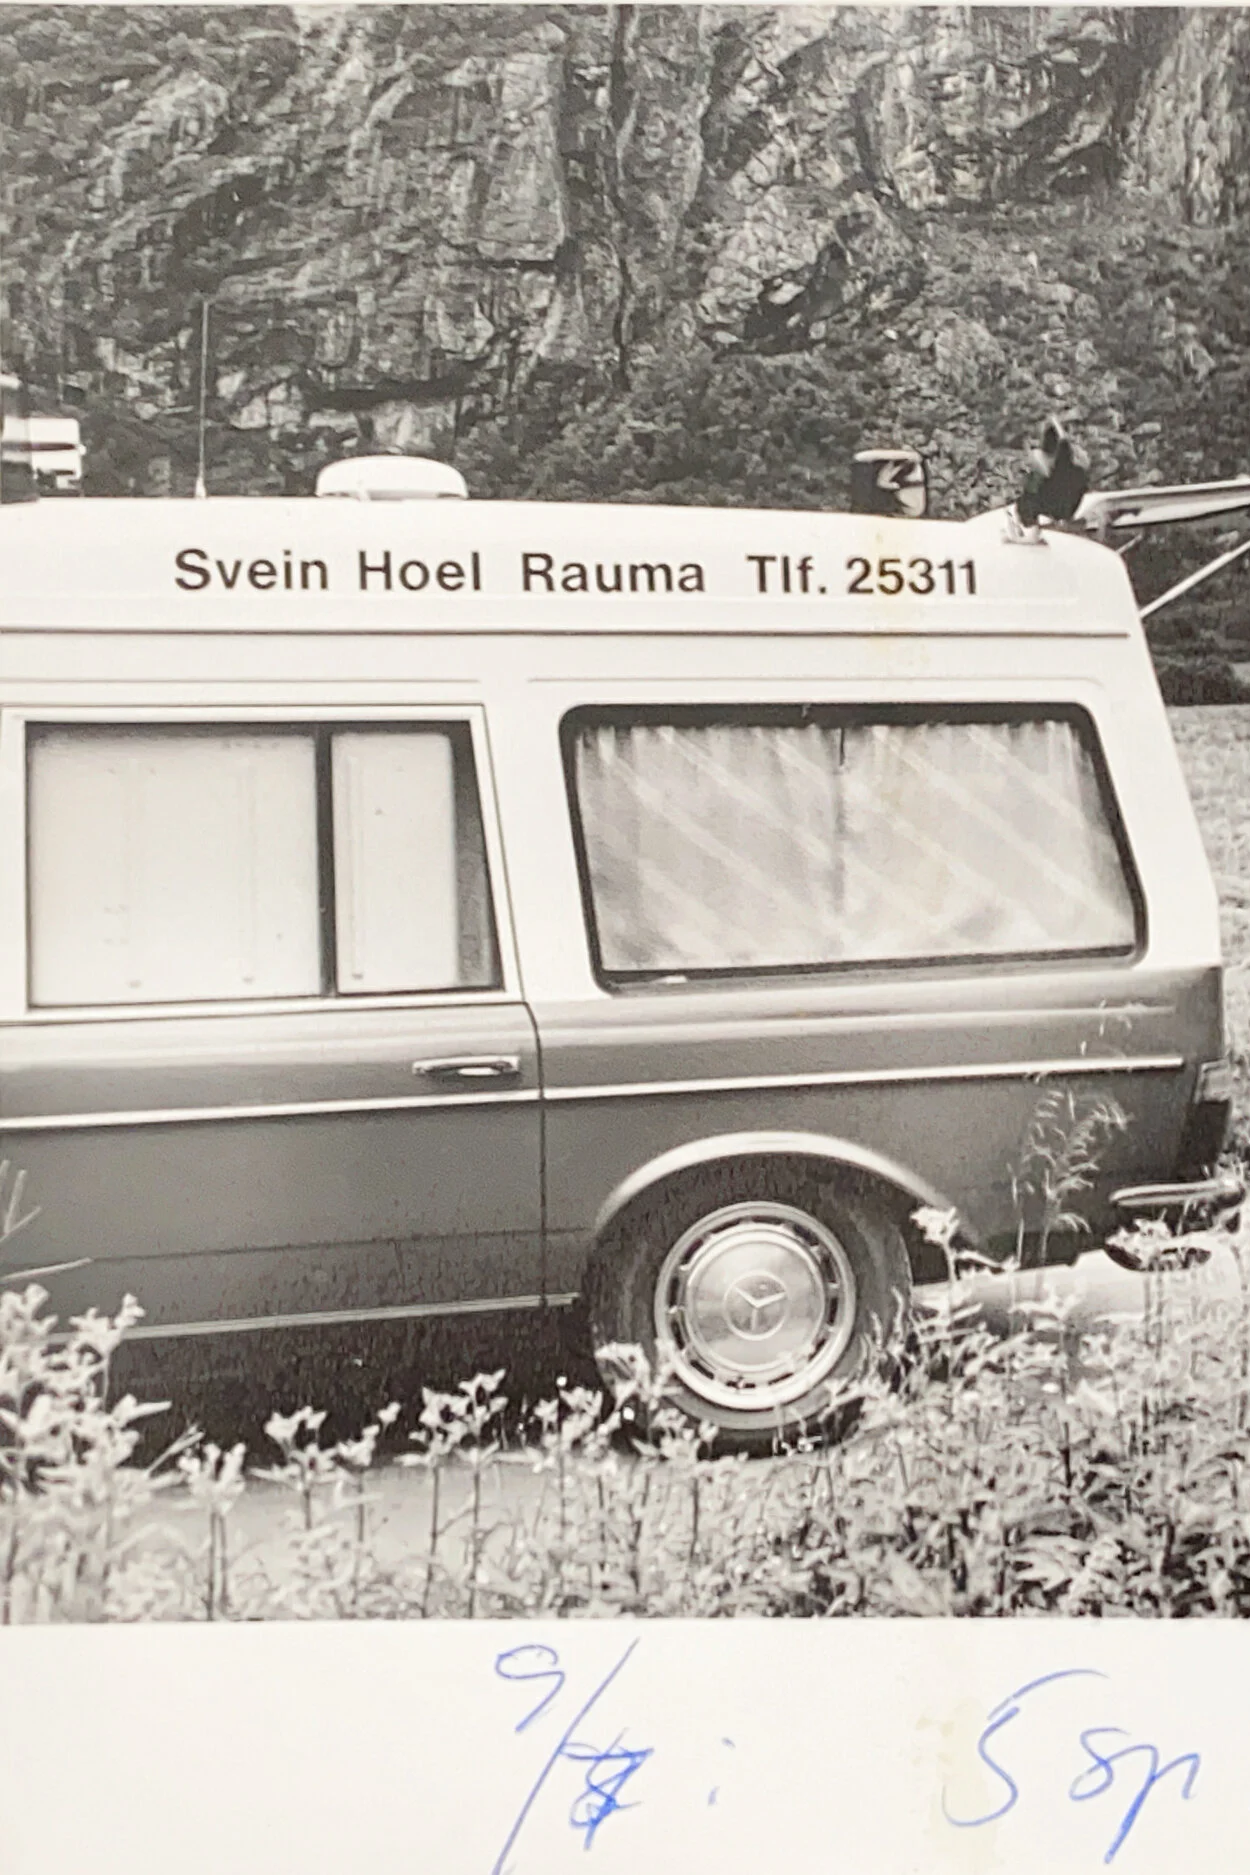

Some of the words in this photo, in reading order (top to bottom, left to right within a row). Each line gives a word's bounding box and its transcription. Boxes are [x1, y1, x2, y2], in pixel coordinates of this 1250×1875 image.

[175, 548, 329, 590] Svein
[359, 551, 481, 591] Hoel
[521, 553, 704, 593] Rauma
[747, 555, 826, 594] Tlf.
[847, 557, 976, 595] 25311
